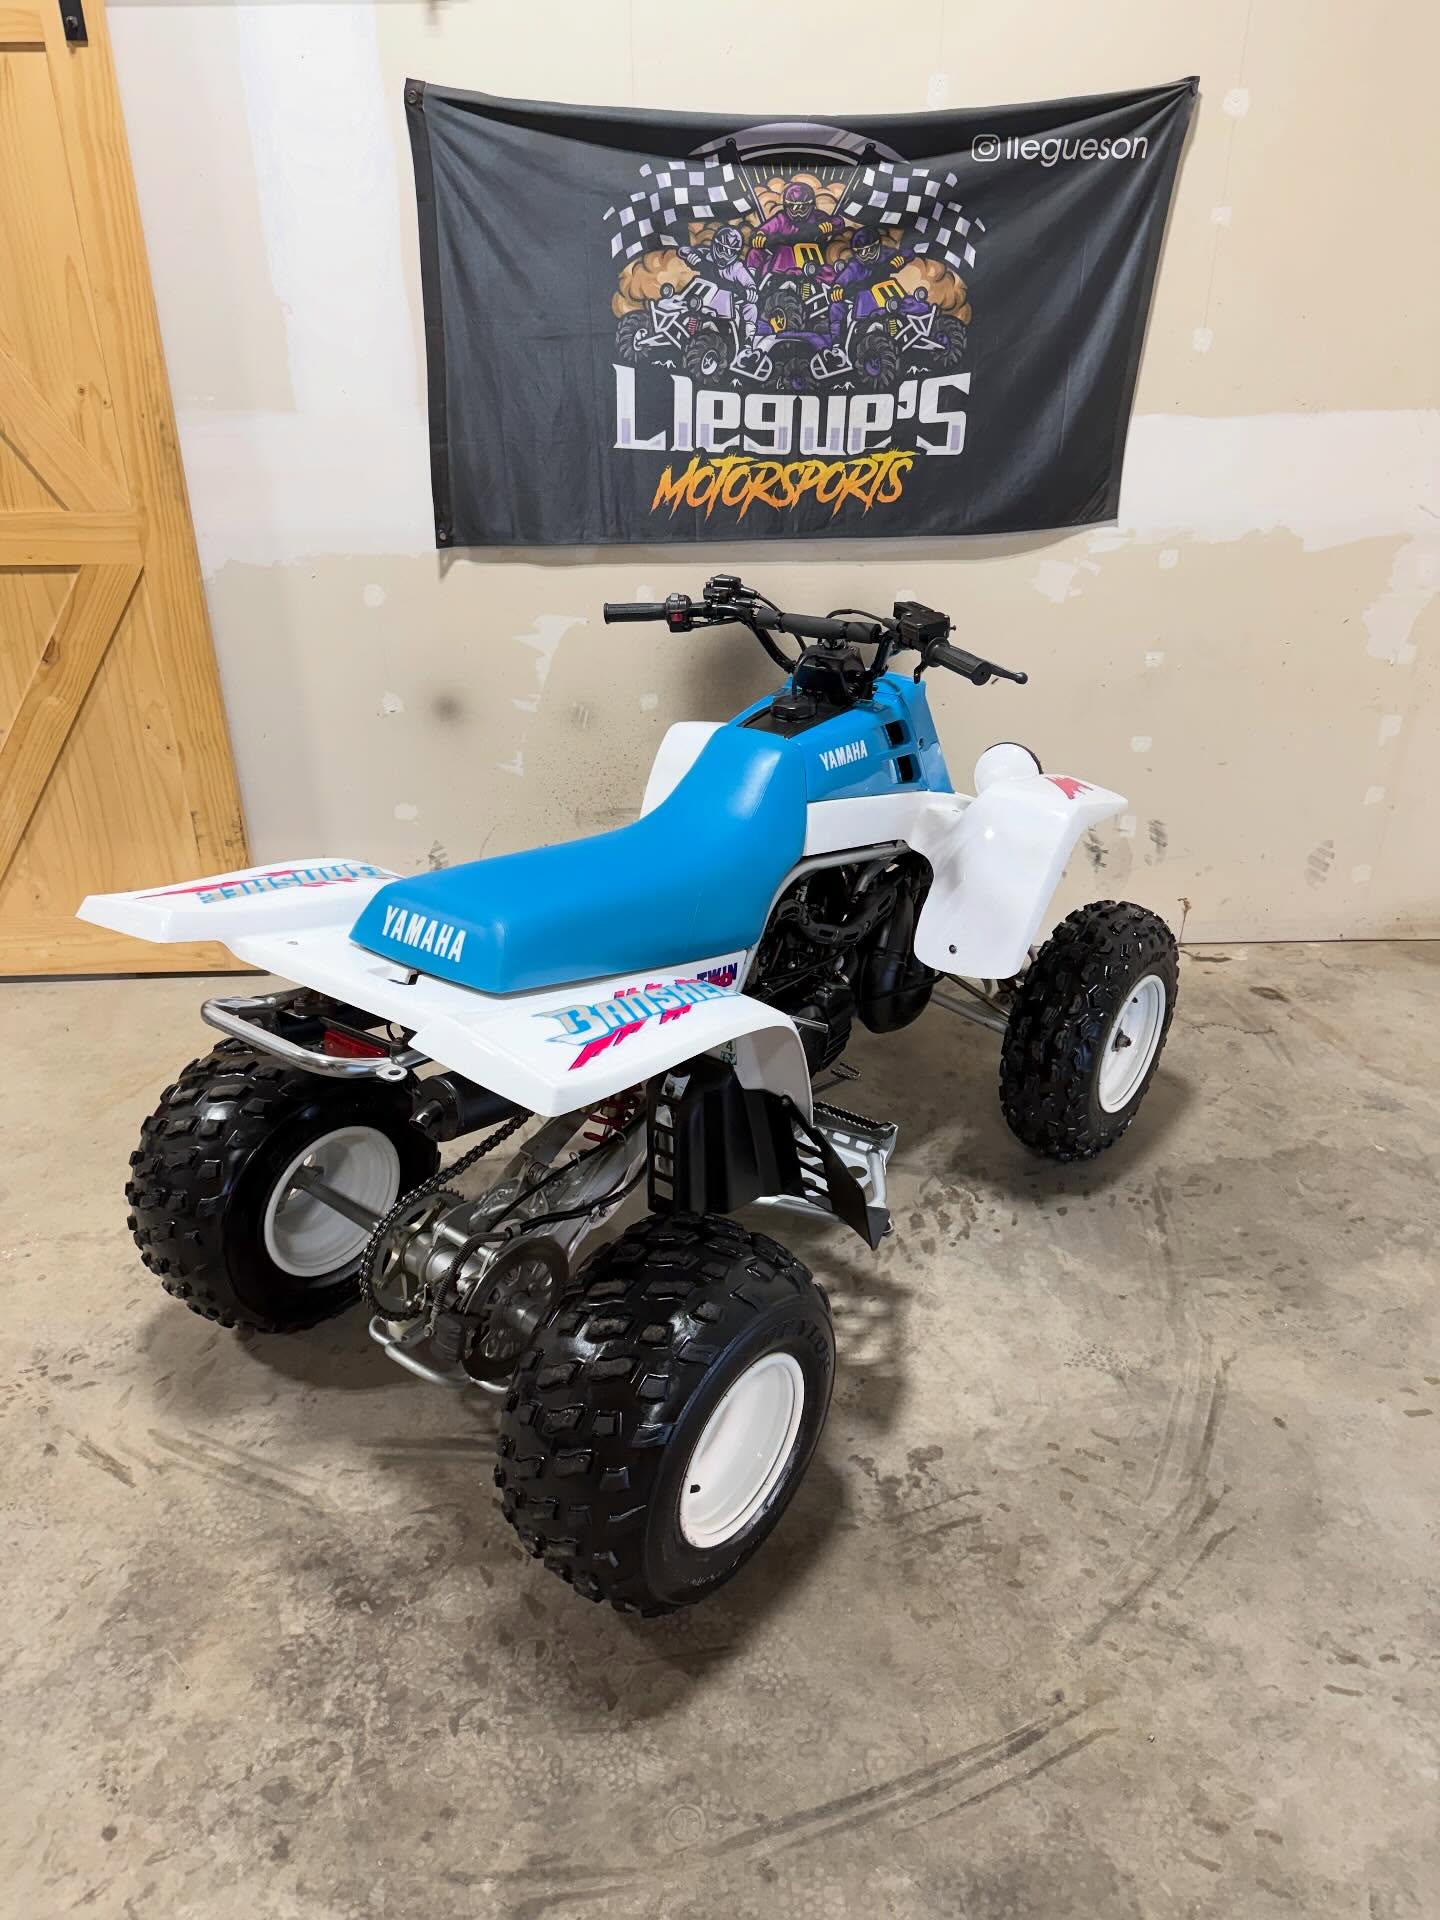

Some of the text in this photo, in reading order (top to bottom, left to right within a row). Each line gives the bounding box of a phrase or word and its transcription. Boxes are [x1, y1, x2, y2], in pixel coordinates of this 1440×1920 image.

[649, 448, 921, 526] MOTORSPORTS
[819, 740, 868, 771] YAMAHA
[382, 904, 467, 963] YAMAHA
